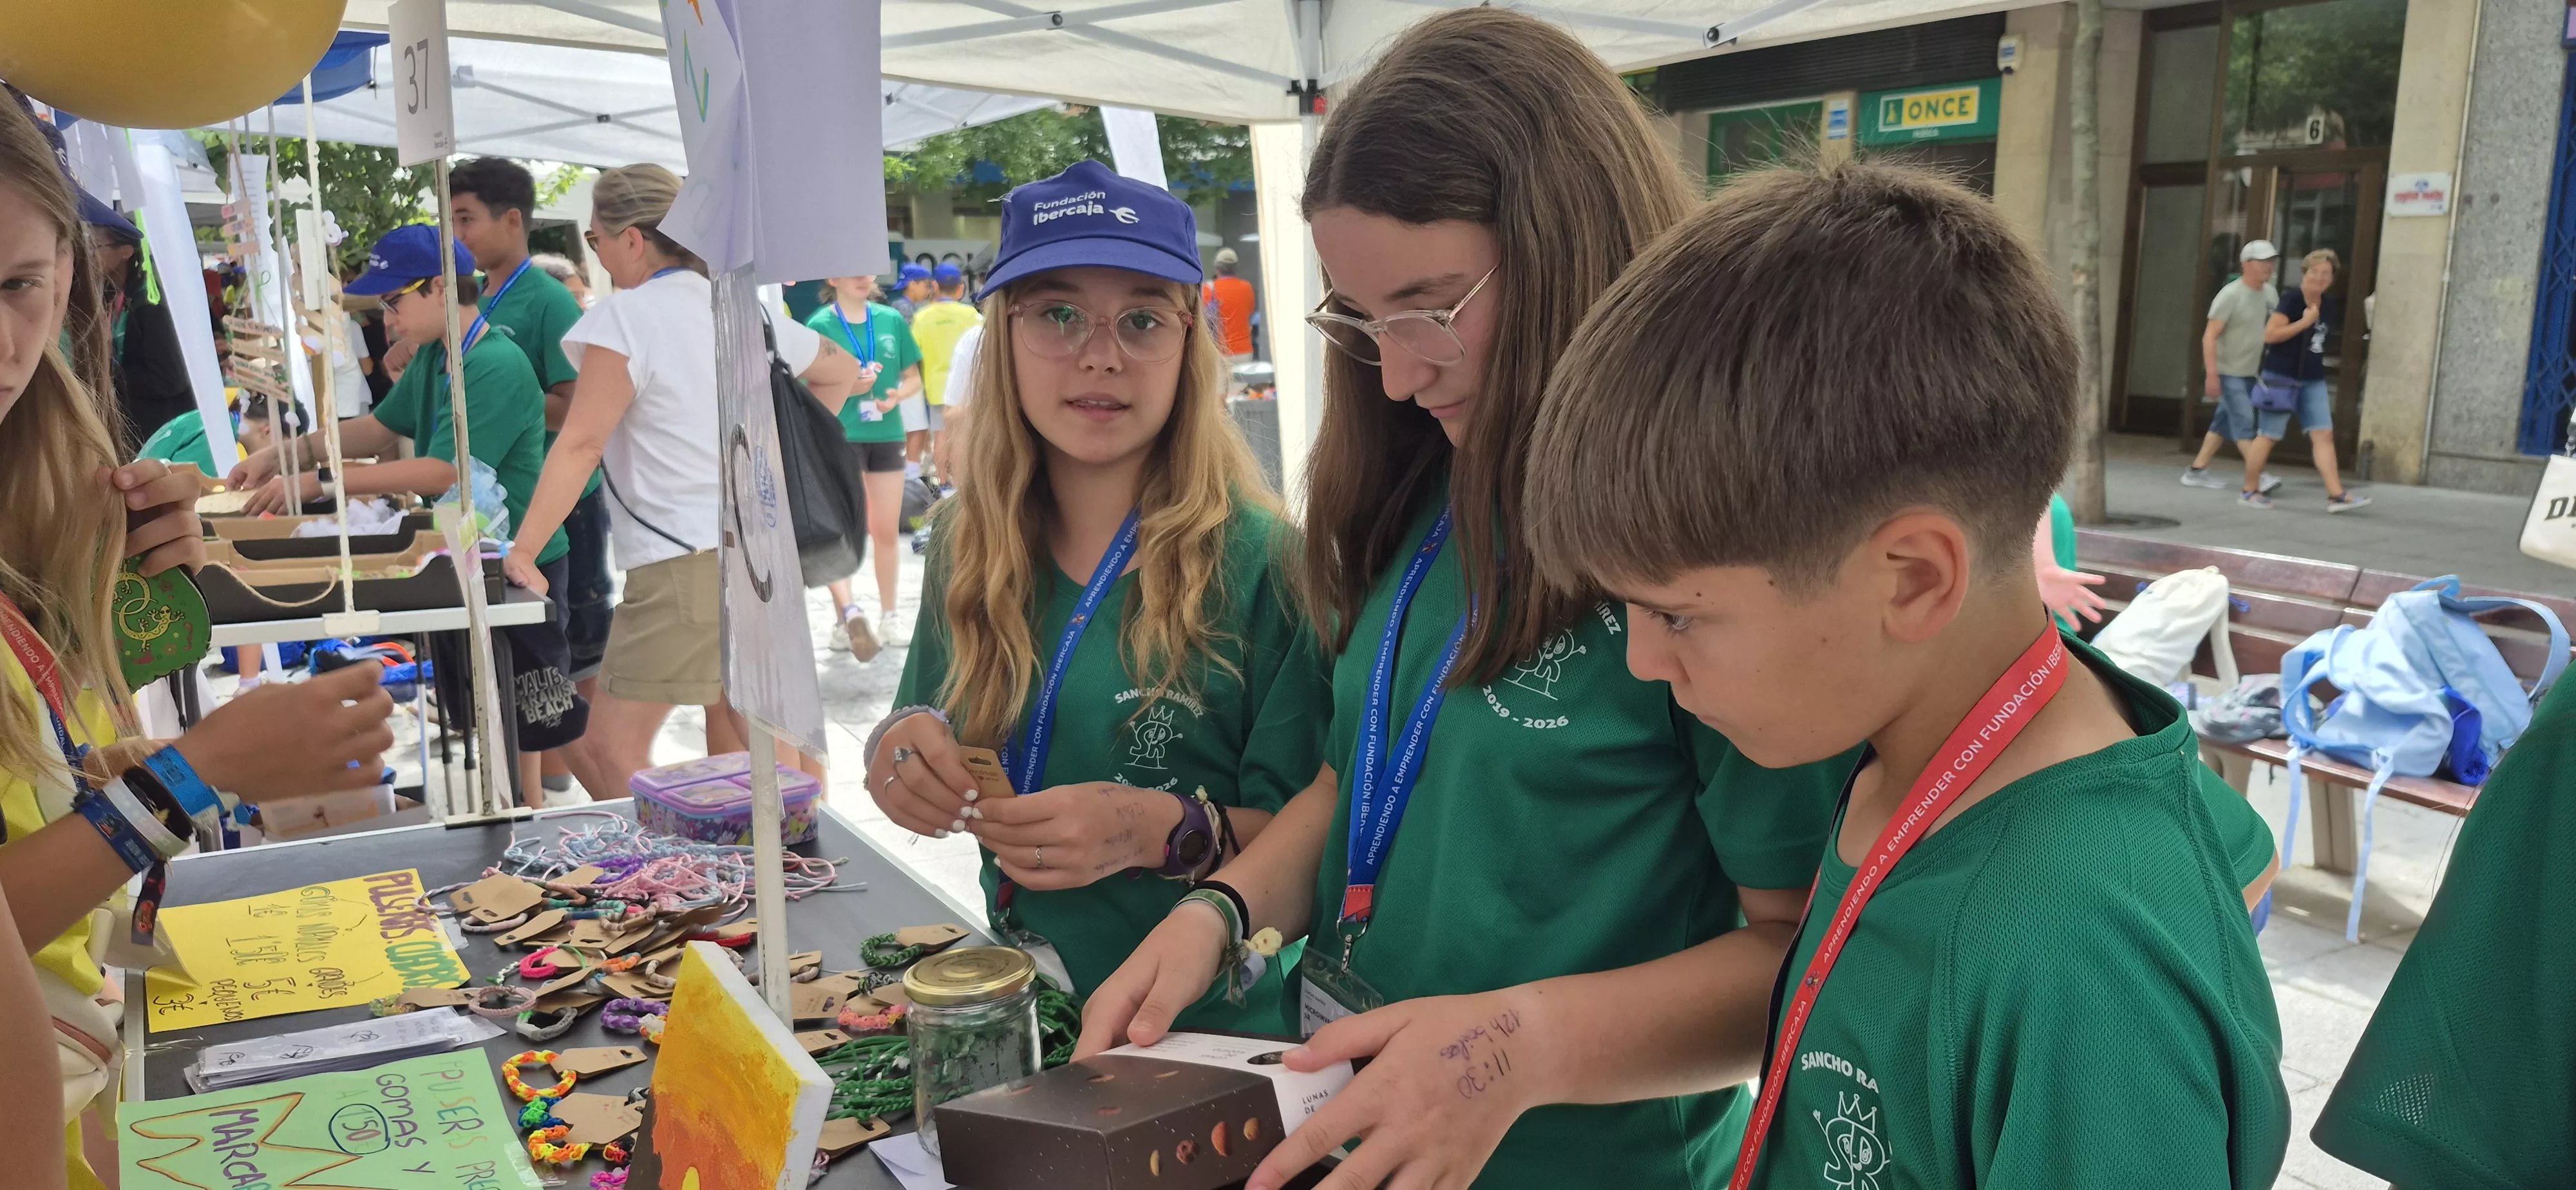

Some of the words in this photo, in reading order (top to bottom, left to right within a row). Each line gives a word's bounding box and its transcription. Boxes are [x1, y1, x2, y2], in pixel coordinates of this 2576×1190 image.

[404, 38, 429, 115] 37
[1908, 96, 1971, 120] ONCE
[2309, 120, 2320, 140] 6
[1034, 191, 1106, 211] Fundación
[1034, 200, 1104, 225] Ibercaja
[1084, 551, 1122, 609] APRENDIENDO
[1119, 544, 1128, 552] A
[1389, 557, 1423, 627] APRENDIENDO
[1386, 630, 1392, 638] A
[1055, 630, 1076, 672] IBERCAJA
[1372, 640, 1390, 706] EMPRENDER
[525, 695, 574, 724] BEACH
[1037, 672, 1057, 725] FUNDACIÓN
[1420, 695, 1435, 719] CON
[1482, 685, 1510, 718] 2019
[1522, 715, 1569, 730] 2026
[1033, 725, 1043, 745] CON
[1369, 708, 1378, 733] CON
[1362, 734, 1377, 797] FUNDACIÓN
[1394, 719, 1425, 785] EMPRENDER
[1391, 785, 1400, 795] A
[1823, 865, 1879, 963] APRENDIENDO
[1879, 854, 1888, 865] A
[1886, 770, 1958, 853] EMPRENDER
[1953, 739, 1984, 771] CON
[1978, 664, 2051, 742] FUNDACIÓN
[1366, 793, 1397, 865] APRENDIENDO
[243, 976, 298, 1001] 5€
[1457, 1047, 1511, 1099] 11:30
[1801, 1051, 1853, 1077] SANCHO
[1302, 1089, 1330, 1105] LUNAS
[1743, 1145, 1755, 1173] CON
[1779, 999, 1807, 1066] IBERCAJA
[375, 1073, 428, 1149] GOMAS
[1304, 1104, 1316, 1115] DE
[401, 1161, 437, 1174] Y
